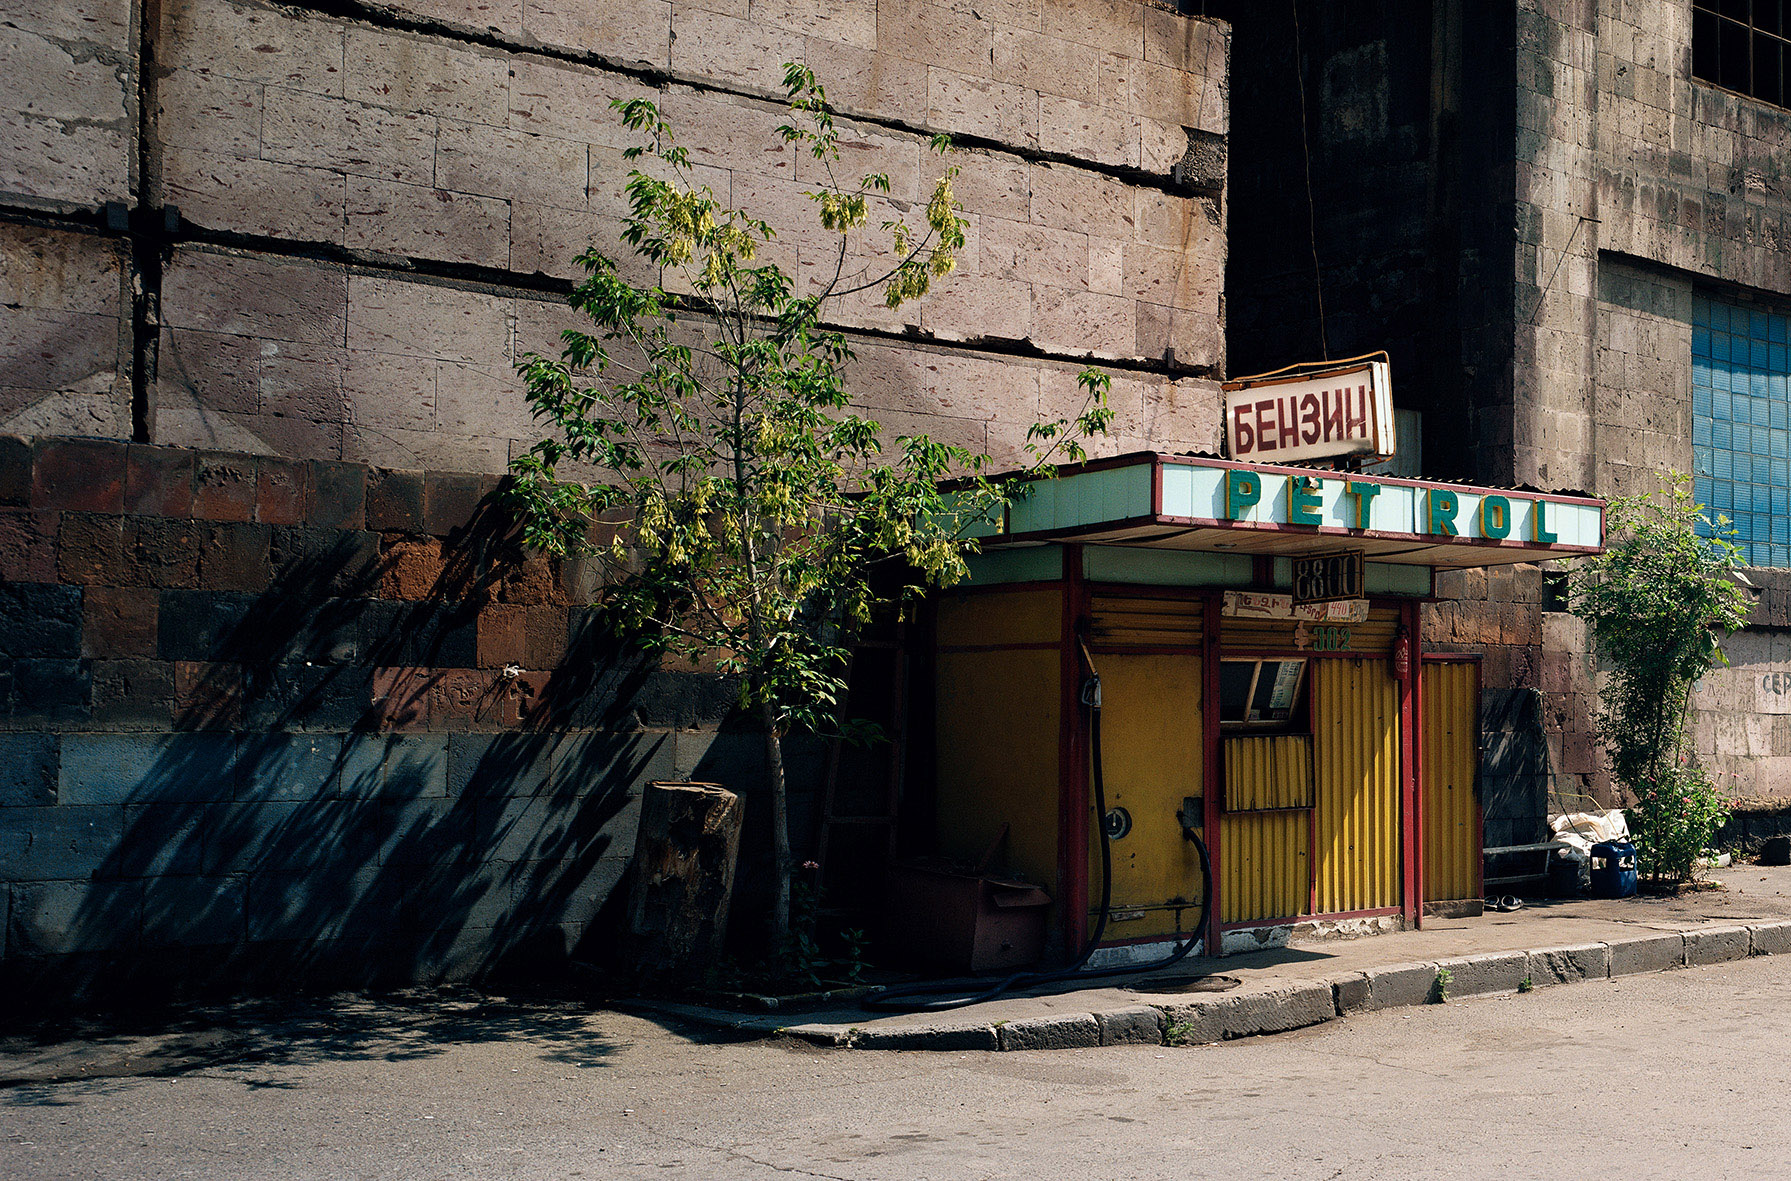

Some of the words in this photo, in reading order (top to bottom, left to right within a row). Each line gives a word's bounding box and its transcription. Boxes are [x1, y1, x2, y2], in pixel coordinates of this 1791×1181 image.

[1234, 384, 1367, 454] БЕНЗИН
[1225, 468, 1558, 543] PETROL
[1331, 601, 1347, 616] 440
